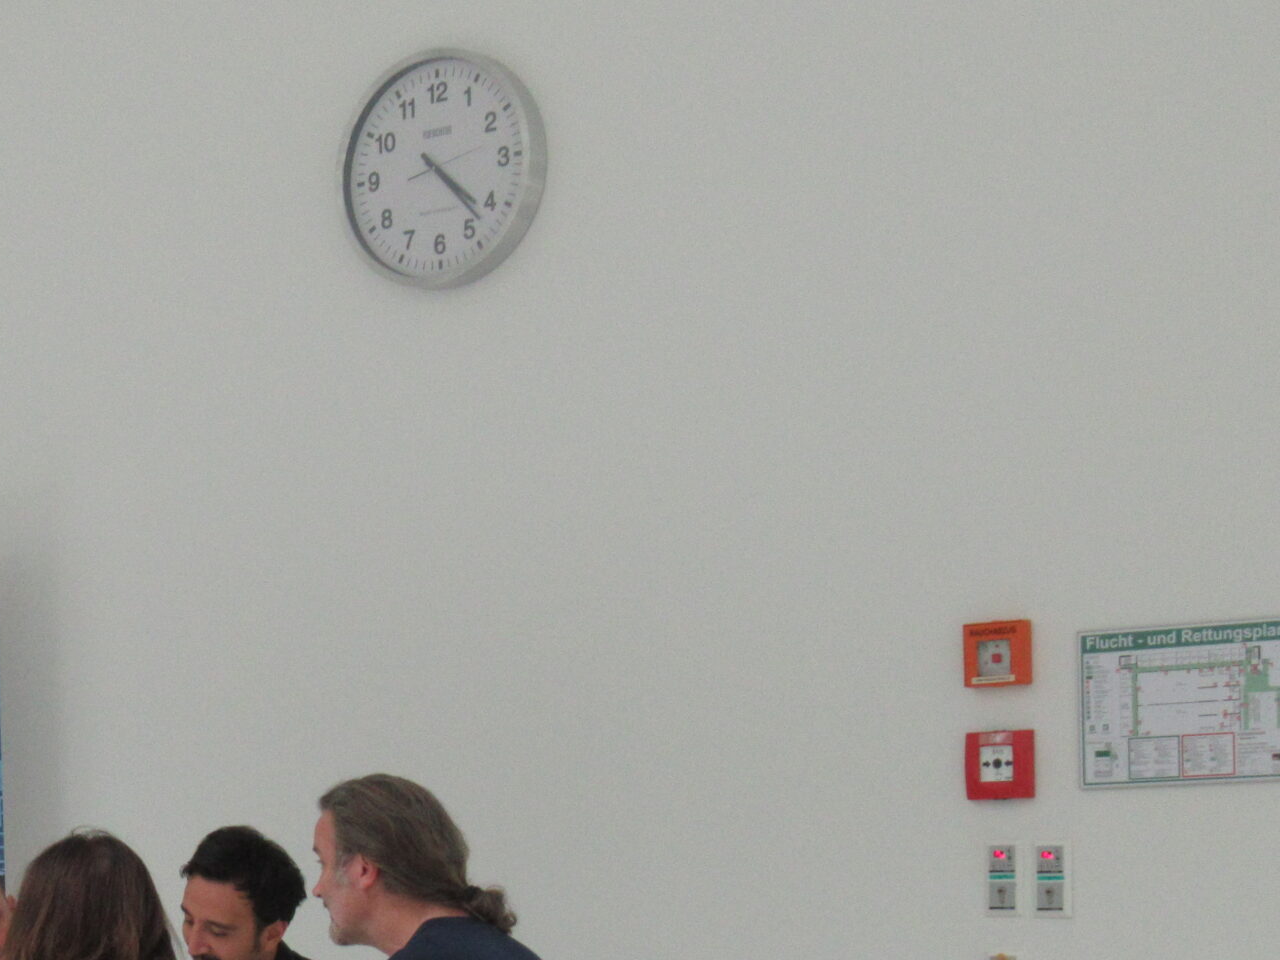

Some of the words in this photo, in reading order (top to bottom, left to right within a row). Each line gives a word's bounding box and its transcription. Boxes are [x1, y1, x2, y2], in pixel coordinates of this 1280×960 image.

[427, 82, 448, 104] 12
[464, 86, 472, 106] 1
[399, 98, 416, 120] 11
[484, 112, 497, 133] 2
[375, 132, 396, 154] 10
[497, 146, 510, 167] 3
[368, 172, 380, 192] 9
[483, 190, 496, 211] 4
[381, 209, 393, 229] 8
[464, 218, 476, 240] 5
[403, 229, 415, 250] 7
[434, 234, 446, 254] 6
[1086, 635, 1133, 650] Flucht
[1147, 631, 1176, 646] und
